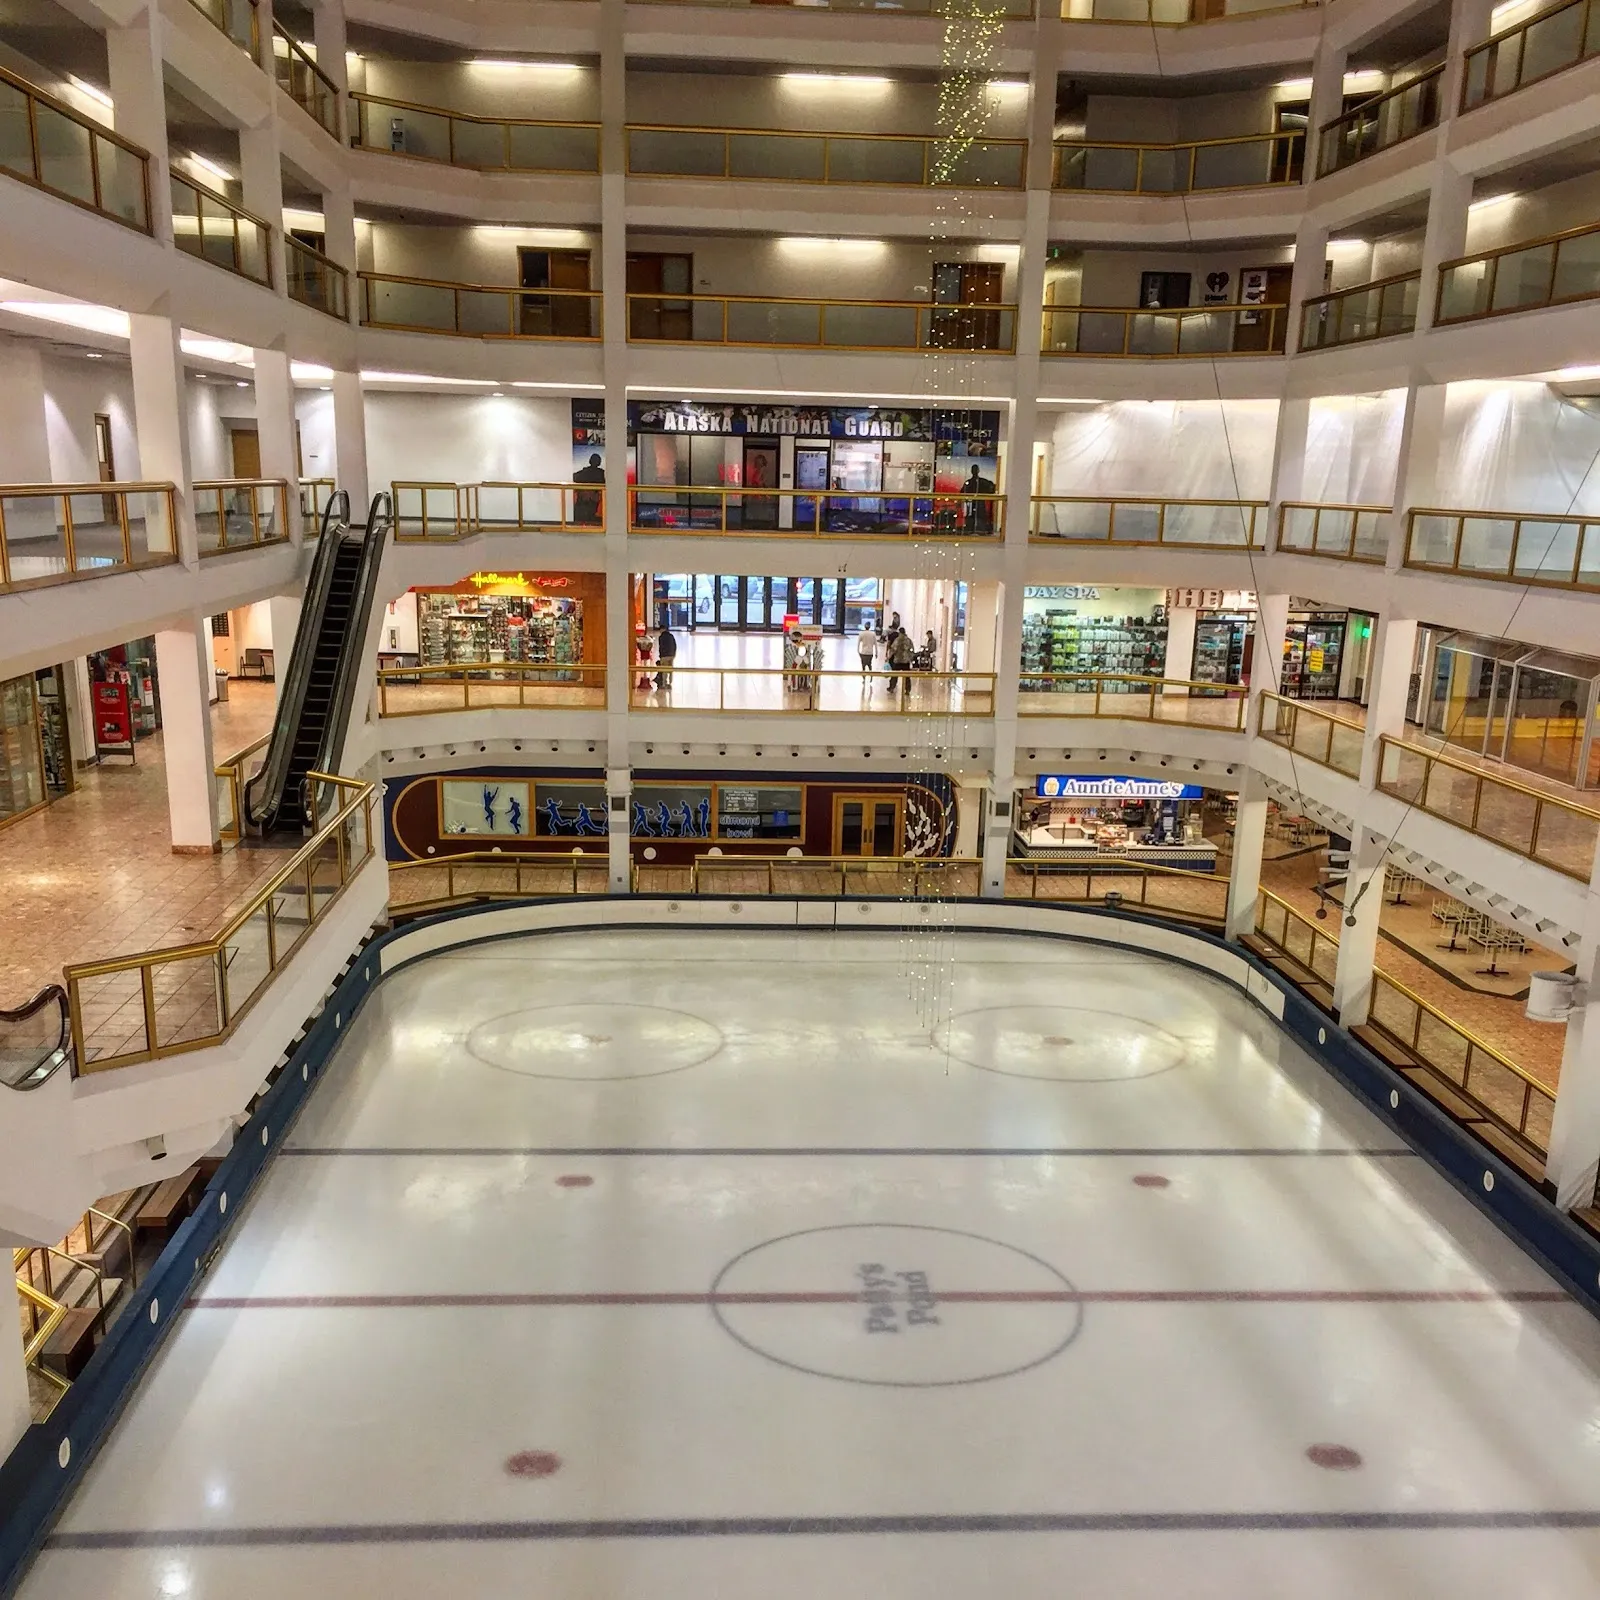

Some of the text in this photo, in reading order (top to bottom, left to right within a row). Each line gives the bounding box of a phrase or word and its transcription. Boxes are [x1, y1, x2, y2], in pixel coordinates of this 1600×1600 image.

[664, 411, 904, 437] ALASKA NATIONAL GUARD
[973, 429, 993, 438] BEST
[470, 571, 529, 588] Hallmark
[1023, 585, 1101, 600] DAY SPA
[720, 815, 760, 826] dimond
[727, 828, 754, 838] bowl
